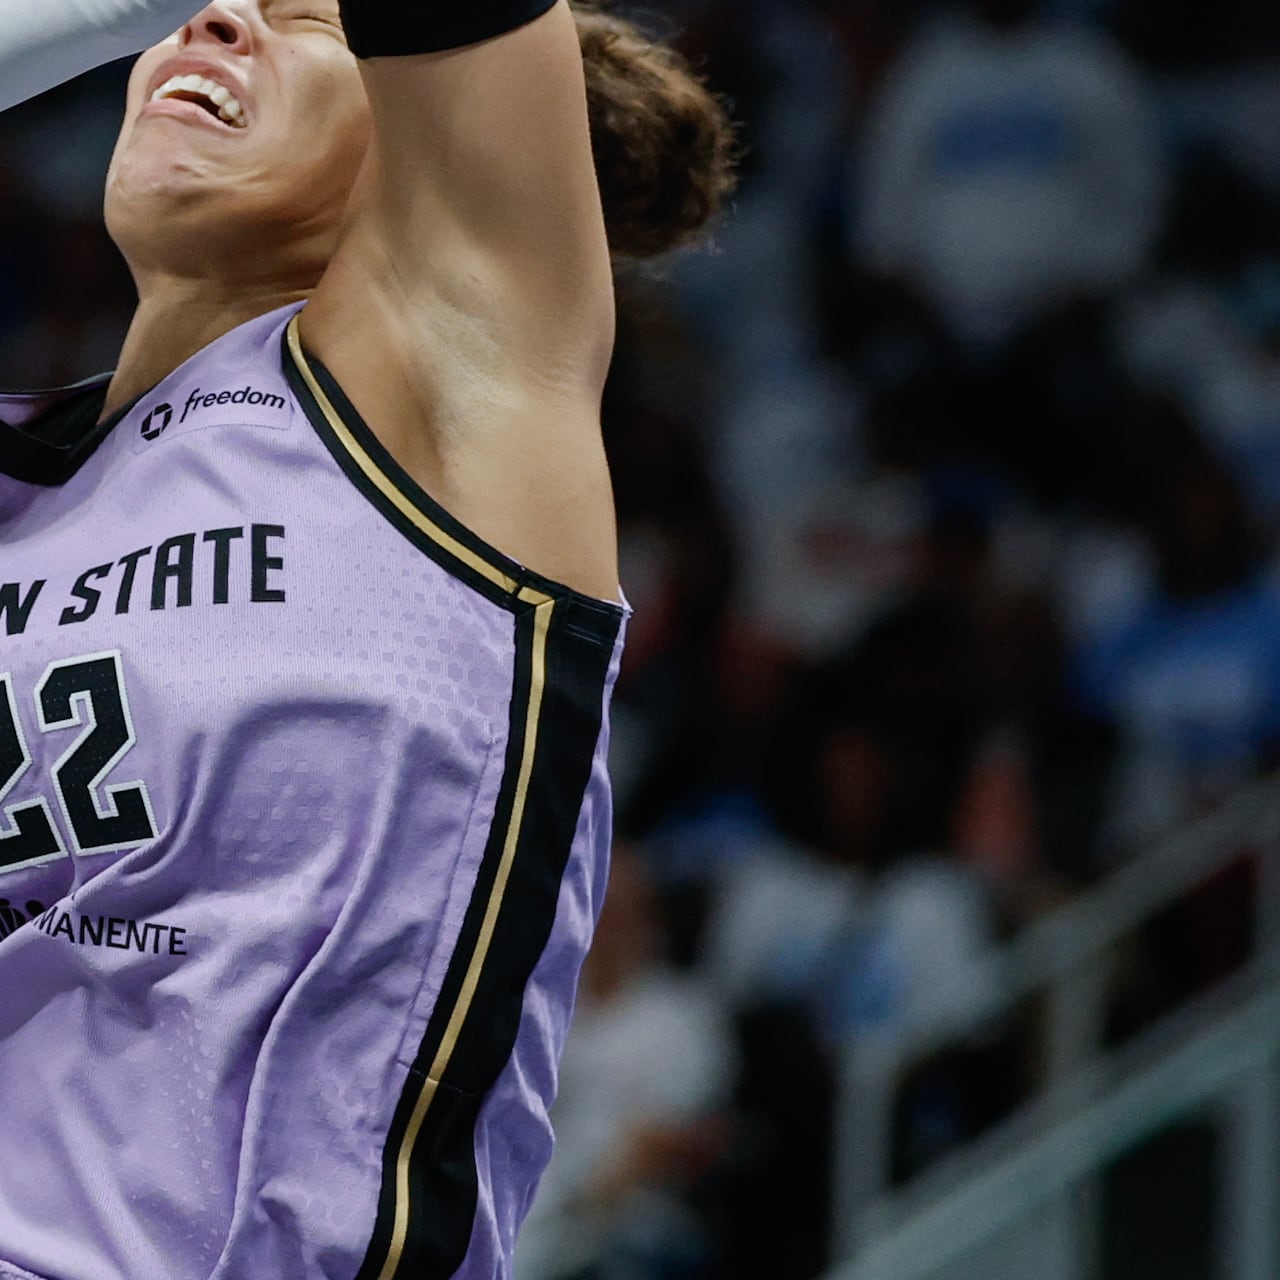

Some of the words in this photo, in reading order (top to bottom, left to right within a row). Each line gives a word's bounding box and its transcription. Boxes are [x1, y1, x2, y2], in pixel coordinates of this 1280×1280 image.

[178, 385, 286, 425] freedom
[58, 523, 286, 626] STATE
[33, 905, 188, 956] MANENTE
